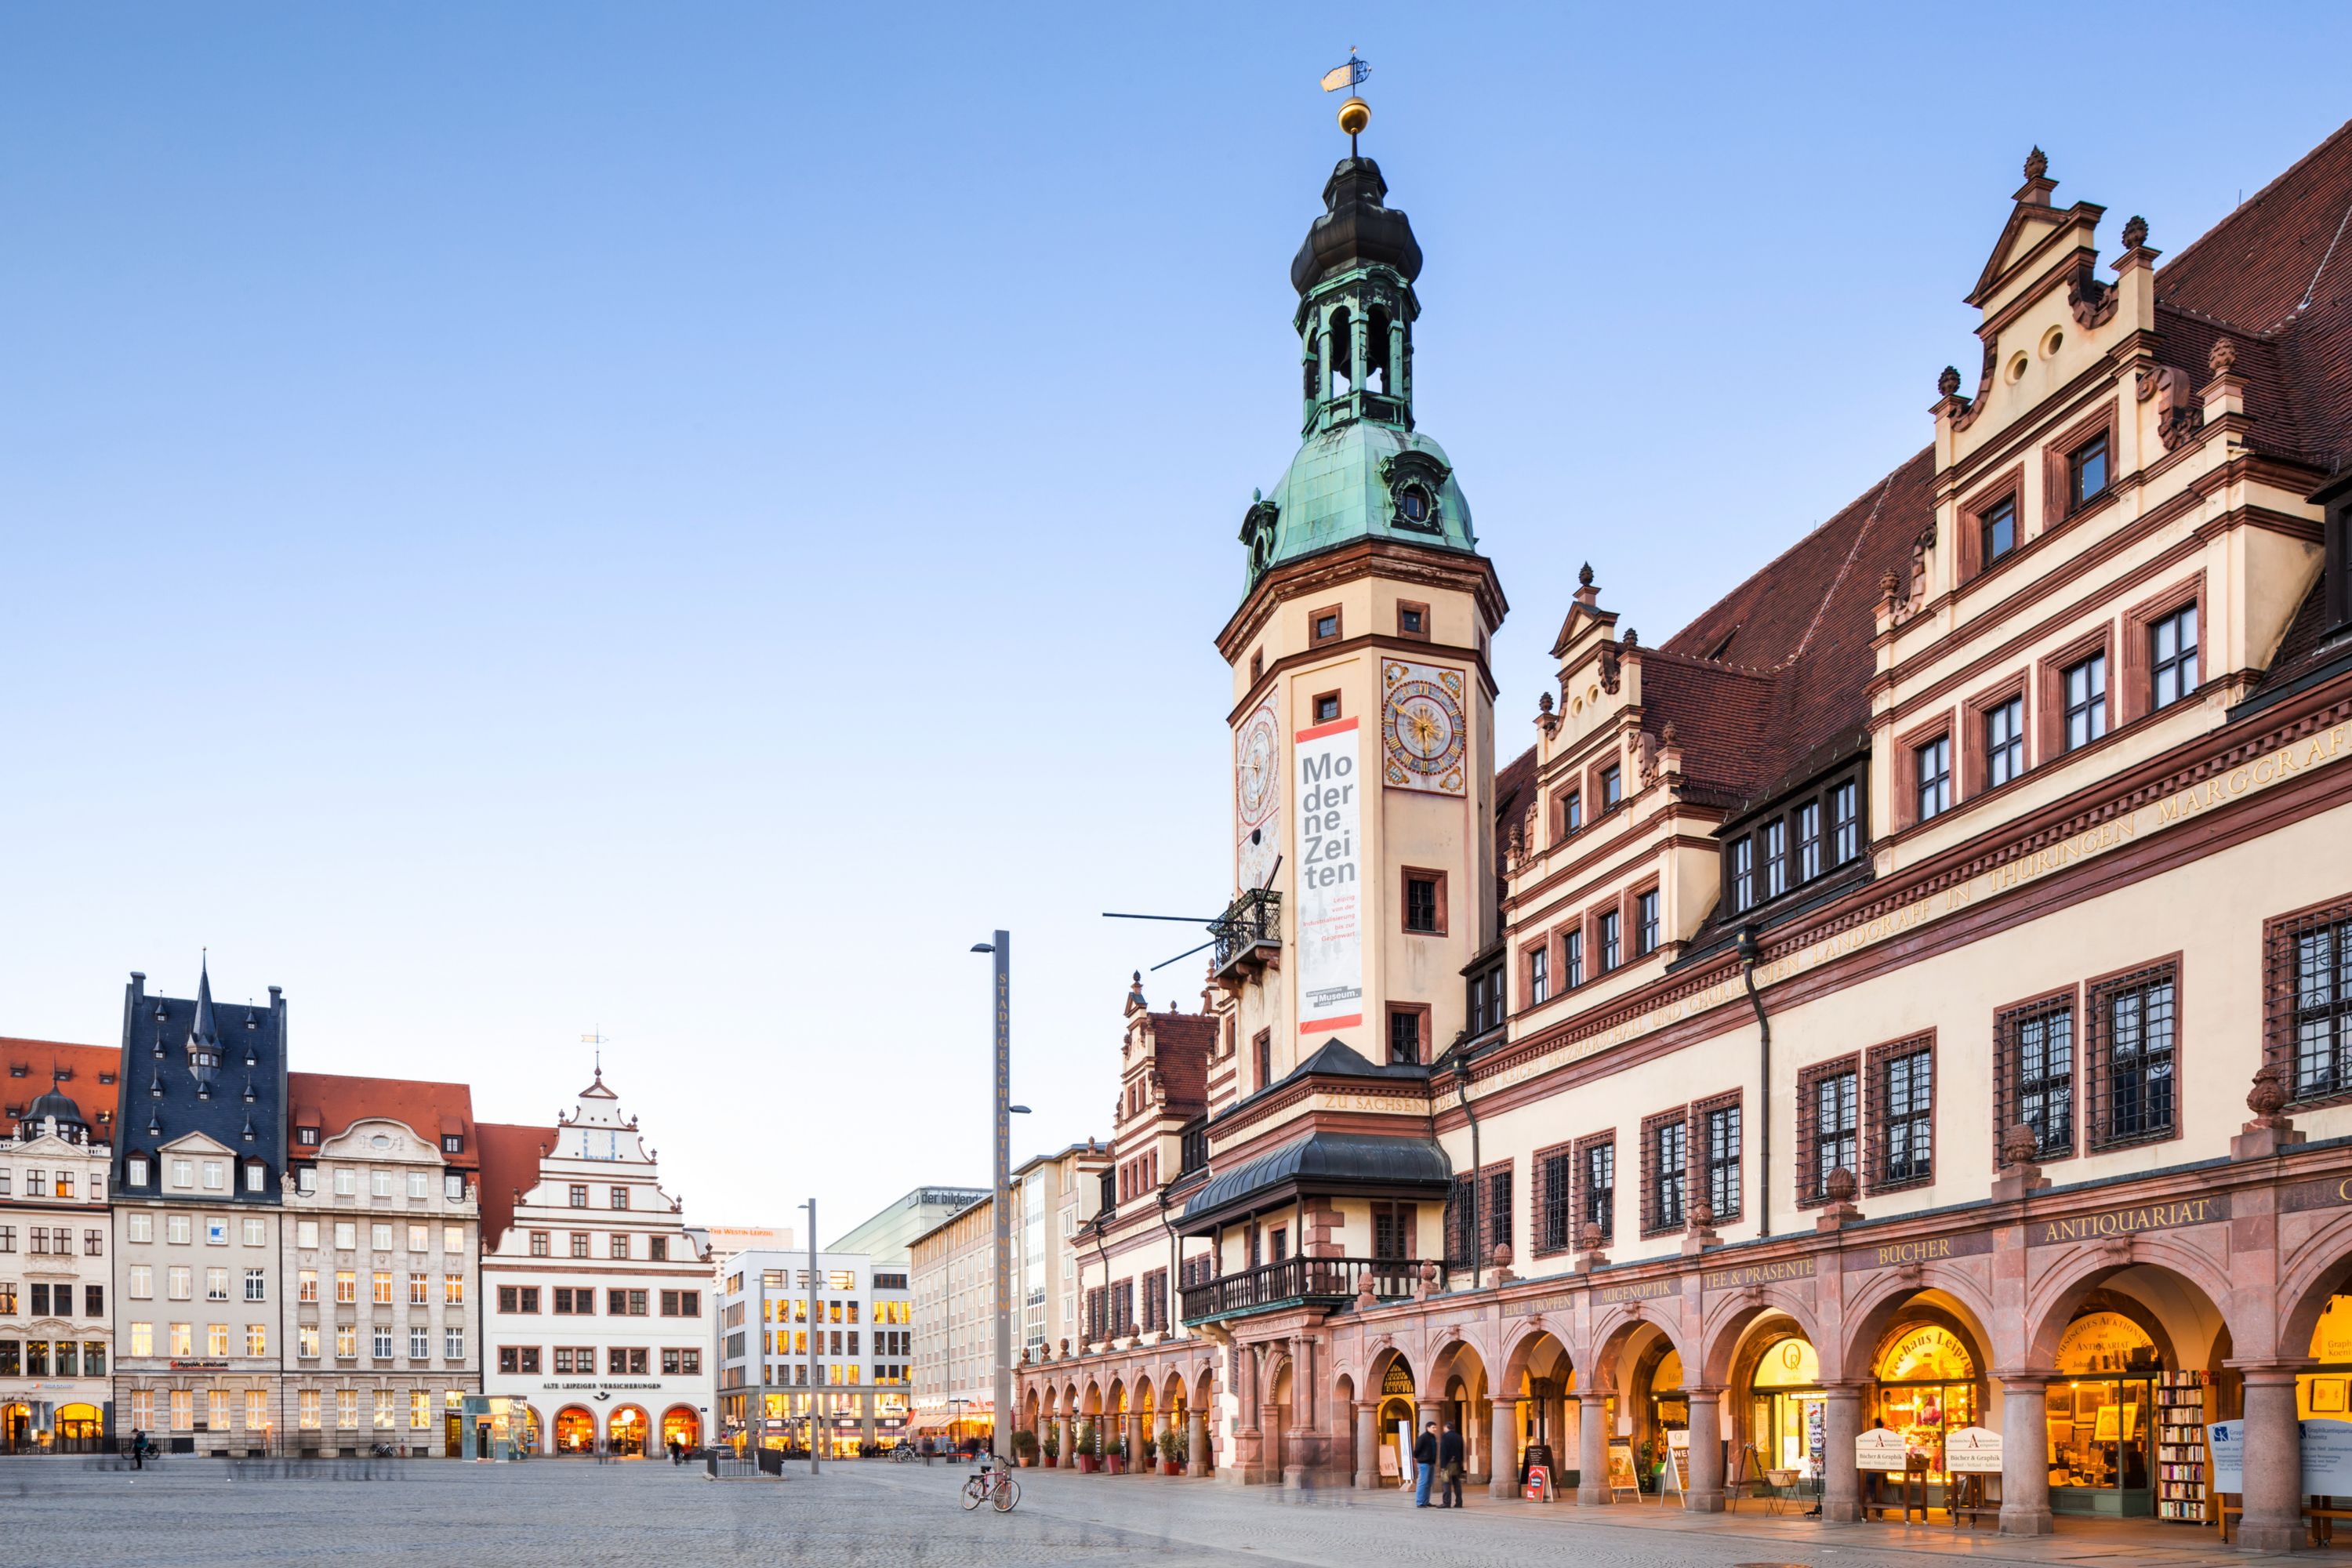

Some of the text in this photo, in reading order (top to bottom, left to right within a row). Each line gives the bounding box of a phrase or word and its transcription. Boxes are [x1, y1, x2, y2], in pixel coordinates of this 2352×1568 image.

[1303, 753, 1352, 784] Mo
[1303, 784, 1354, 813] der
[1304, 810, 1341, 836] ne
[1304, 829, 1351, 865] Zei
[1305, 862, 1356, 890] ten
[1303, 913, 1356, 927] Industrialisierung
[1325, 1096, 1348, 1109] ZU
[1356, 1097, 1426, 1112] SACHSEN
[1440, 1091, 1457, 1110] DES
[1501, 1062, 1541, 1084] REICHS
[1651, 1004, 1682, 1027] UND
[1813, 898, 1931, 965] LANDGRAFF
[1947, 882, 1970, 909] IN
[1987, 813, 2136, 892] THURINGEN
[2157, 723, 2352, 825] MARGGRAF
[1321, 931, 1356, 942] Gegenwart
[997, 973, 1009, 1311] STADTGESCHICHTLICHES MUSEUM
[921, 1192, 938, 1203] der
[2045, 1199, 2210, 1242] ANTIQUARIAT
[1878, 1239, 1951, 1265] BÜCHER
[1704, 1258, 1814, 1288] TEE & PRÄSENTE
[1504, 1294, 1571, 1316] EDLE TROPFEN
[1602, 1280, 1671, 1302] AUGENOPTIK
[1888, 1331, 1975, 1377] Teehaus Leipzig
